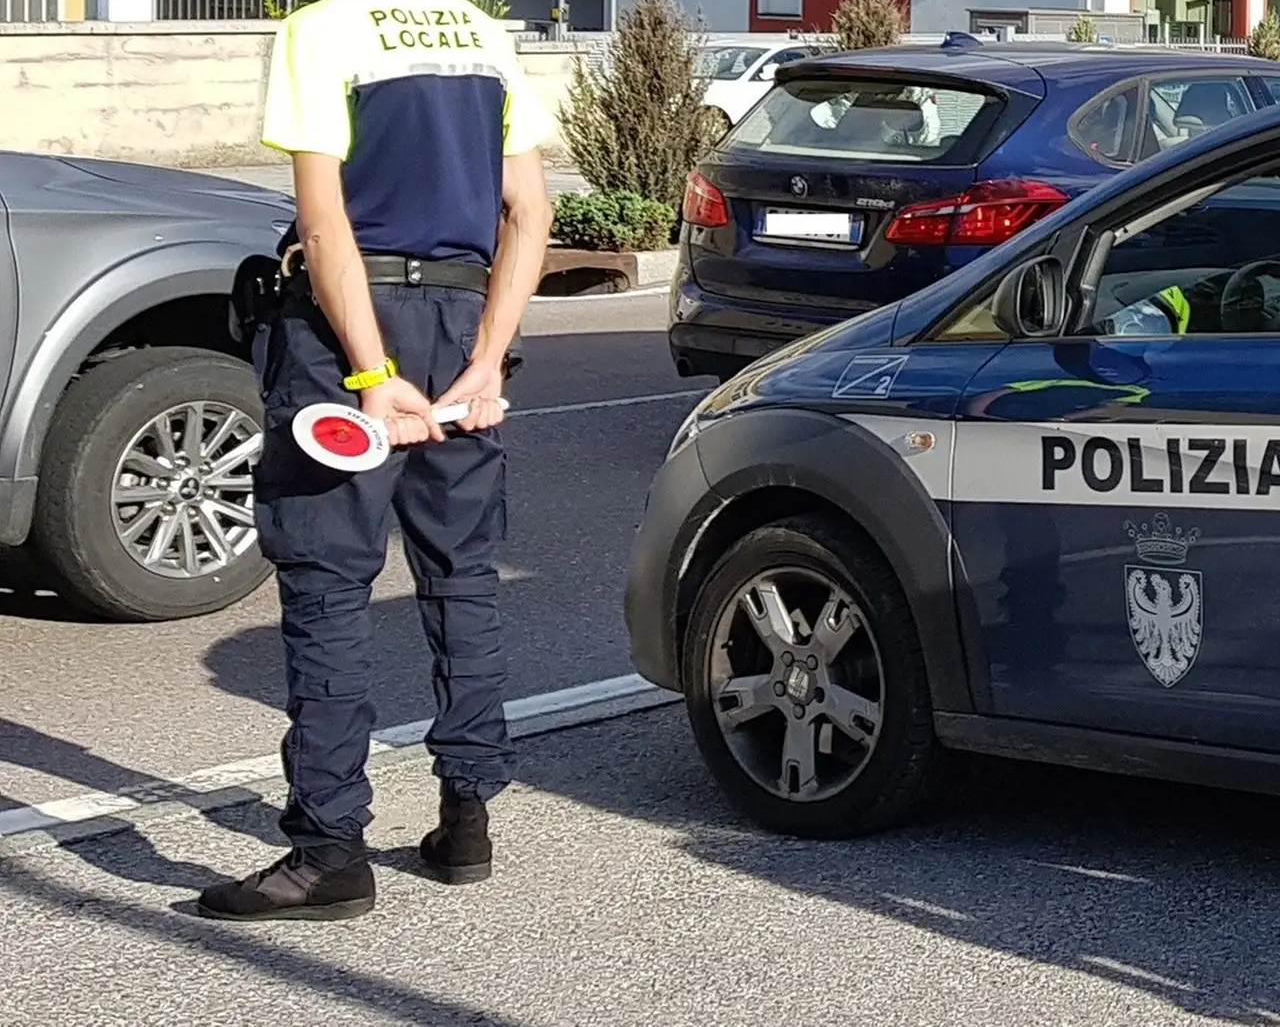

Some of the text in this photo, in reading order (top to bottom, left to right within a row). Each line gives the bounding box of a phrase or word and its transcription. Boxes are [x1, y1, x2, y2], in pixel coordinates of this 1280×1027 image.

[370, 8, 472, 26] POLIZIA
[380, 30, 483, 50] LOCALE
[874, 376, 892, 395] 2
